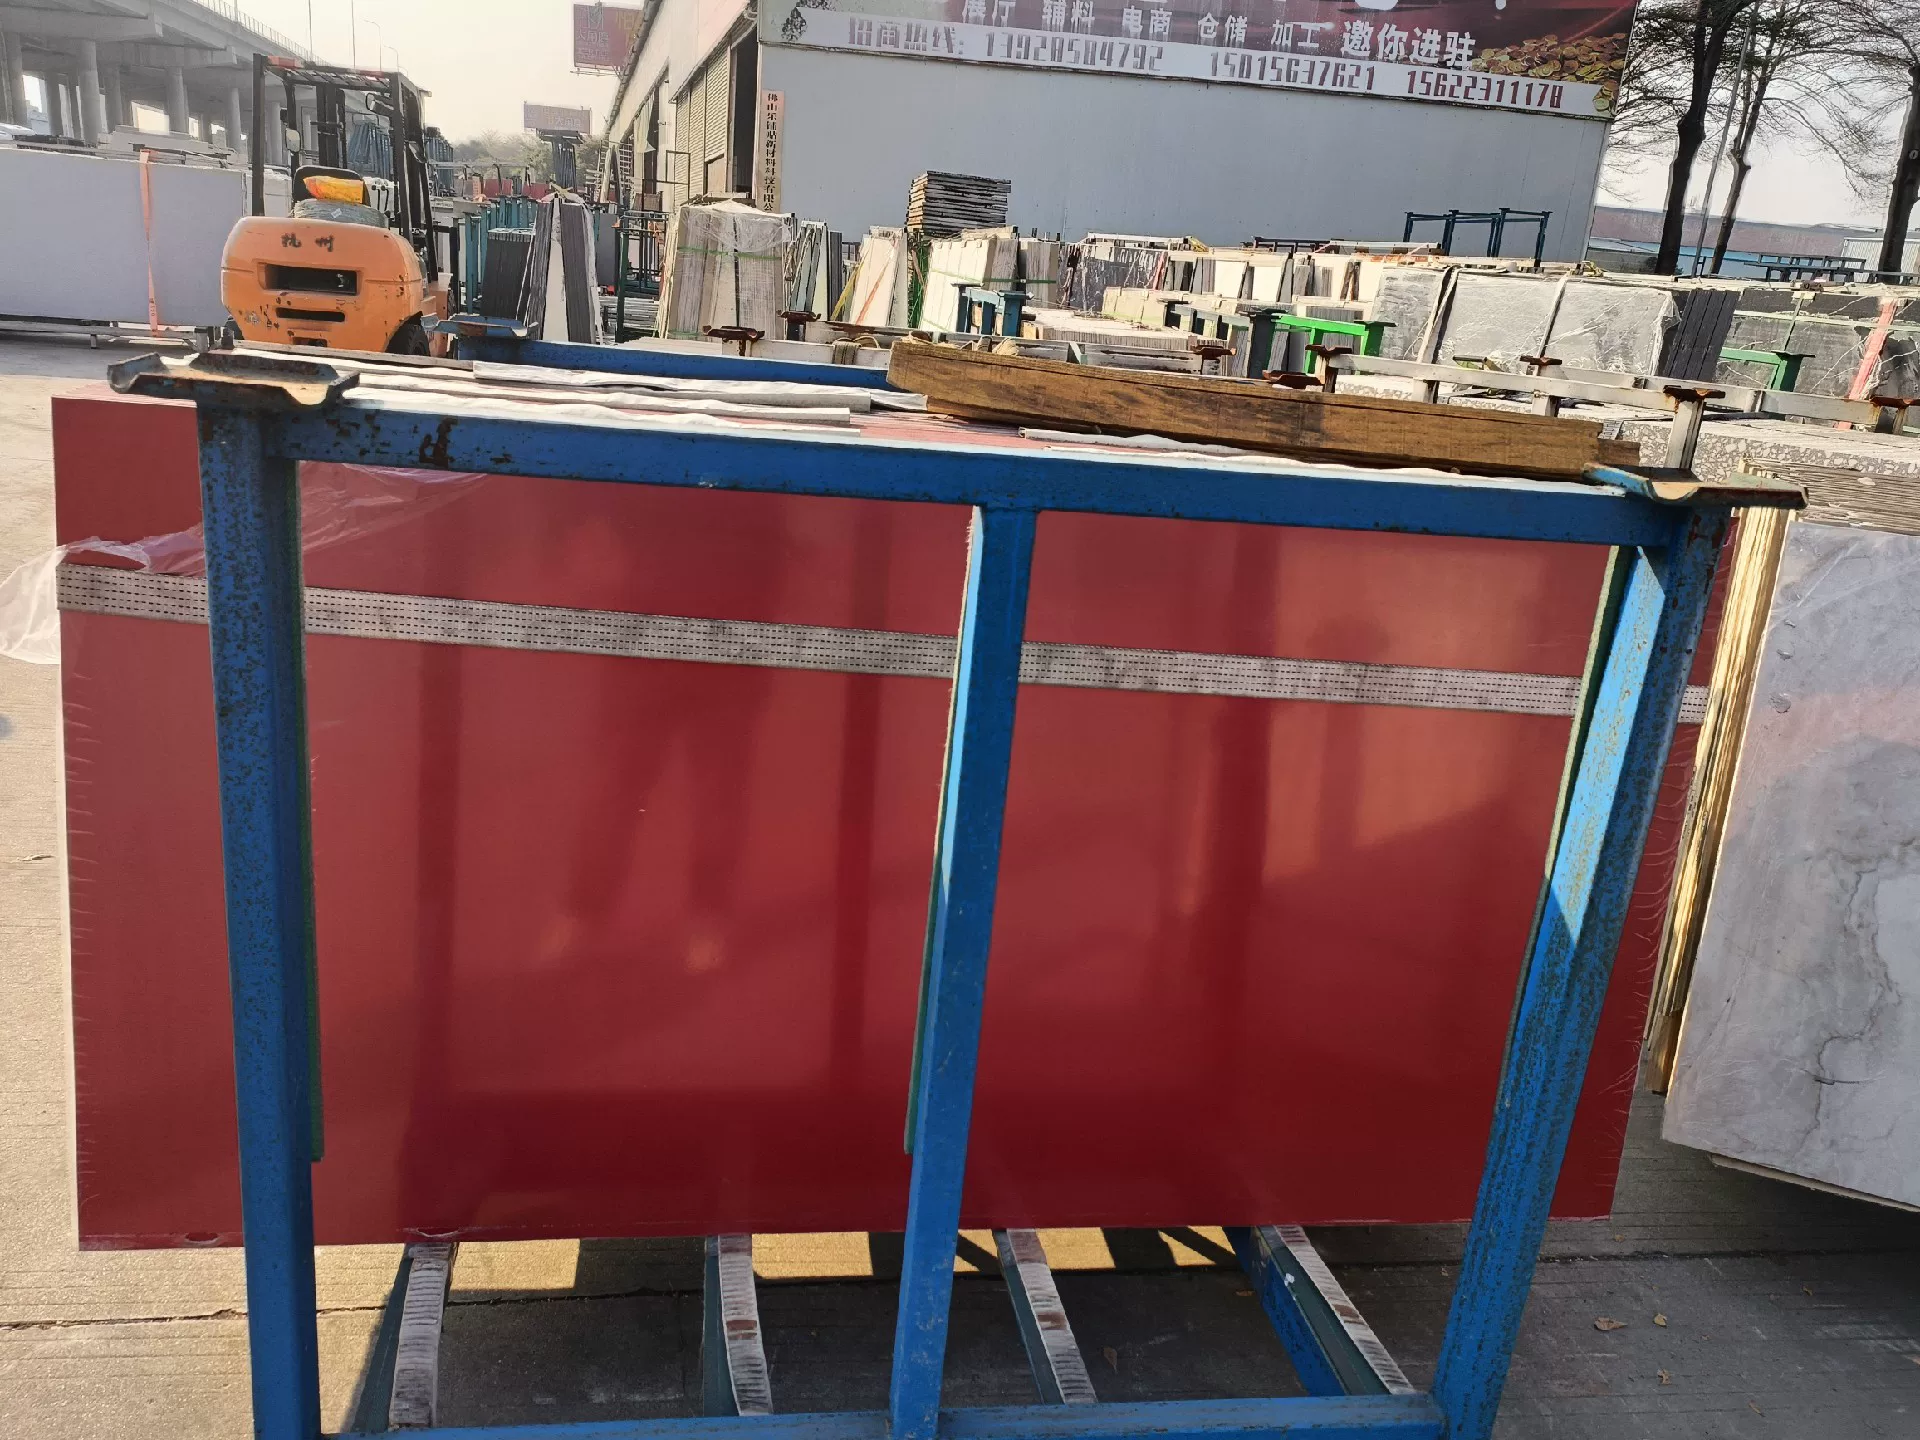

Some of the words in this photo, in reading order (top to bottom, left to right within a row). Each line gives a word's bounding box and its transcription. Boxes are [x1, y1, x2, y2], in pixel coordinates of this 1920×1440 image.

[1122, 5, 1173, 34] 电商
[1197, 11, 1248, 43] 仓储
[1270, 19, 1321, 48] 加工
[1340, 19, 1476, 68] 邀你进驻
[1210, 52, 1375, 91] 15015637621
[1407, 70, 1564, 109] 15622311178
